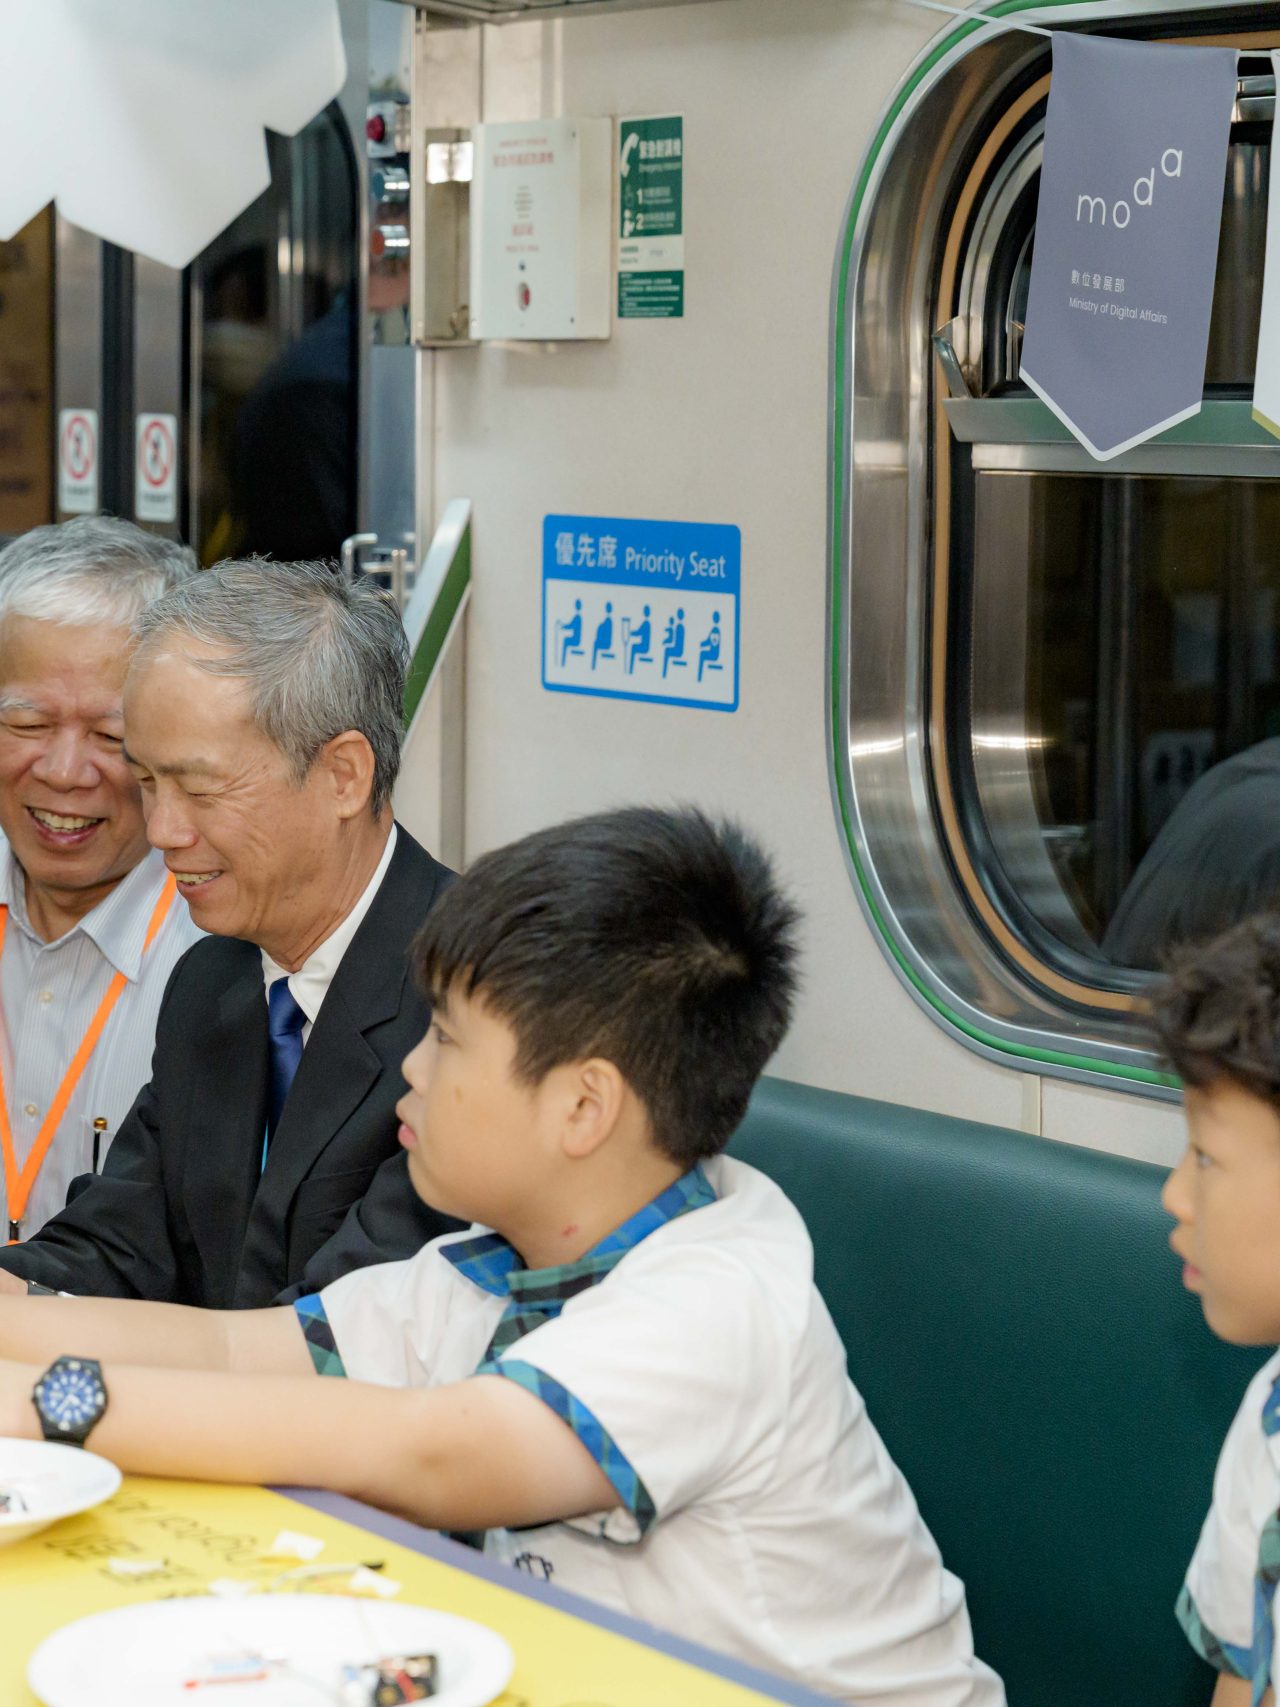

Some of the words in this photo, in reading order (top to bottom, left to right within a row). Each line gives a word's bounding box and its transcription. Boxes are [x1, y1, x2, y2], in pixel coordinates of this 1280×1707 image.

[1077, 148, 1183, 229] moda
[1071, 269, 1125, 293] 數位發展部
[1069, 297, 1099, 315] Ministry
[1100, 303, 1109, 314] of
[1110, 304, 1138, 320] Digital
[1139, 309, 1168, 324] Affairs
[555, 531, 618, 569] 優先席
[625, 546, 685, 582] Priority
[689, 551, 727, 579] Seat
